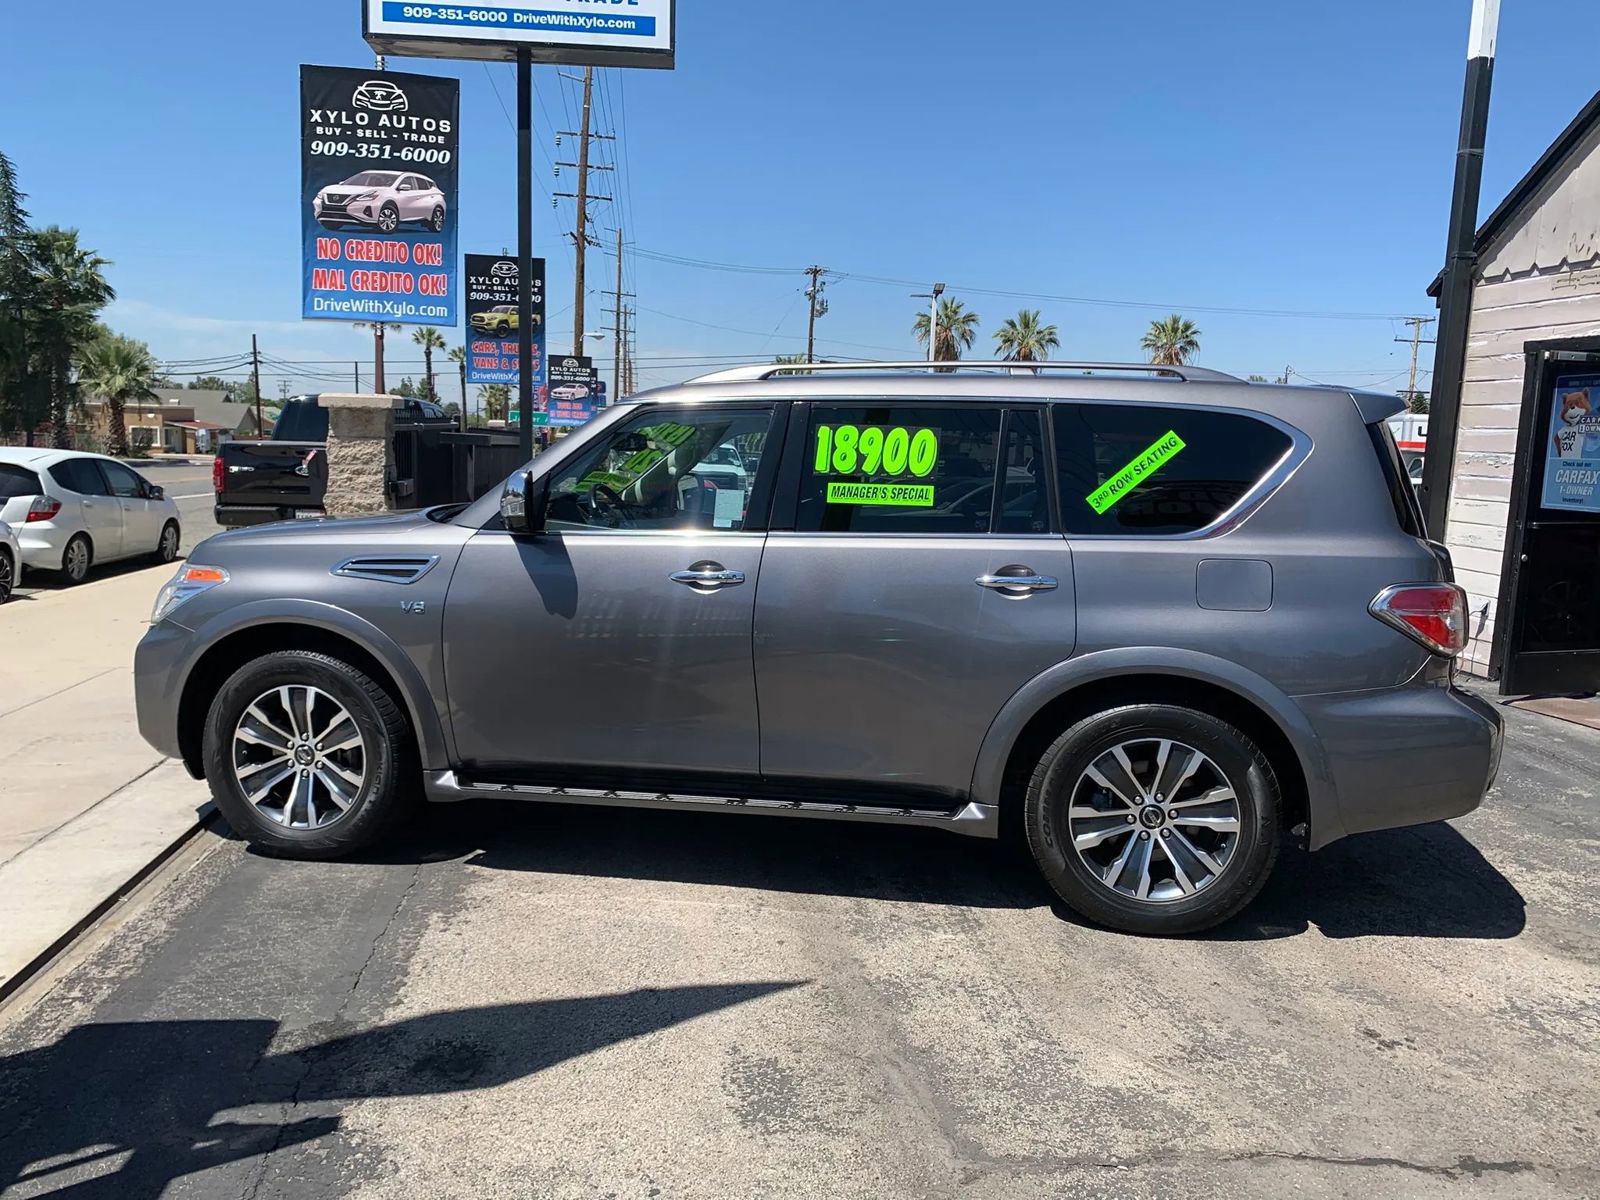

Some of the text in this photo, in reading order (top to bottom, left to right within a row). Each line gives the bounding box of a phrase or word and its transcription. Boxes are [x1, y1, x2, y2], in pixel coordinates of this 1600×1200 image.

[403, 6, 637, 29] 909-351-6000 DriveWithXylo.com
[310, 109, 451, 133] XYLO AUTOS
[316, 126, 342, 136] BUY
[357, 129, 388, 139] SELL
[402, 132, 445, 144] TRADE
[310, 140, 451, 164] 909-351-6000
[316, 237, 443, 266] NO CREDITO OK!
[312, 268, 448, 296] MAL CREDITO OK!
[469, 276, 500, 285] XYLO
[314, 298, 448, 317] DriveWithXylo.com
[471, 341, 499, 356] CARS,
[473, 357, 499, 369] VANS
[501, 358, 509, 369] &
[815, 425, 938, 477] 18900
[1109, 470, 1133, 495] ROW
[1133, 437, 1177, 476] SEATING
[1555, 469, 1598, 485] CARFAX
[831, 485, 930, 500] MANAGER'S SPECIAL
